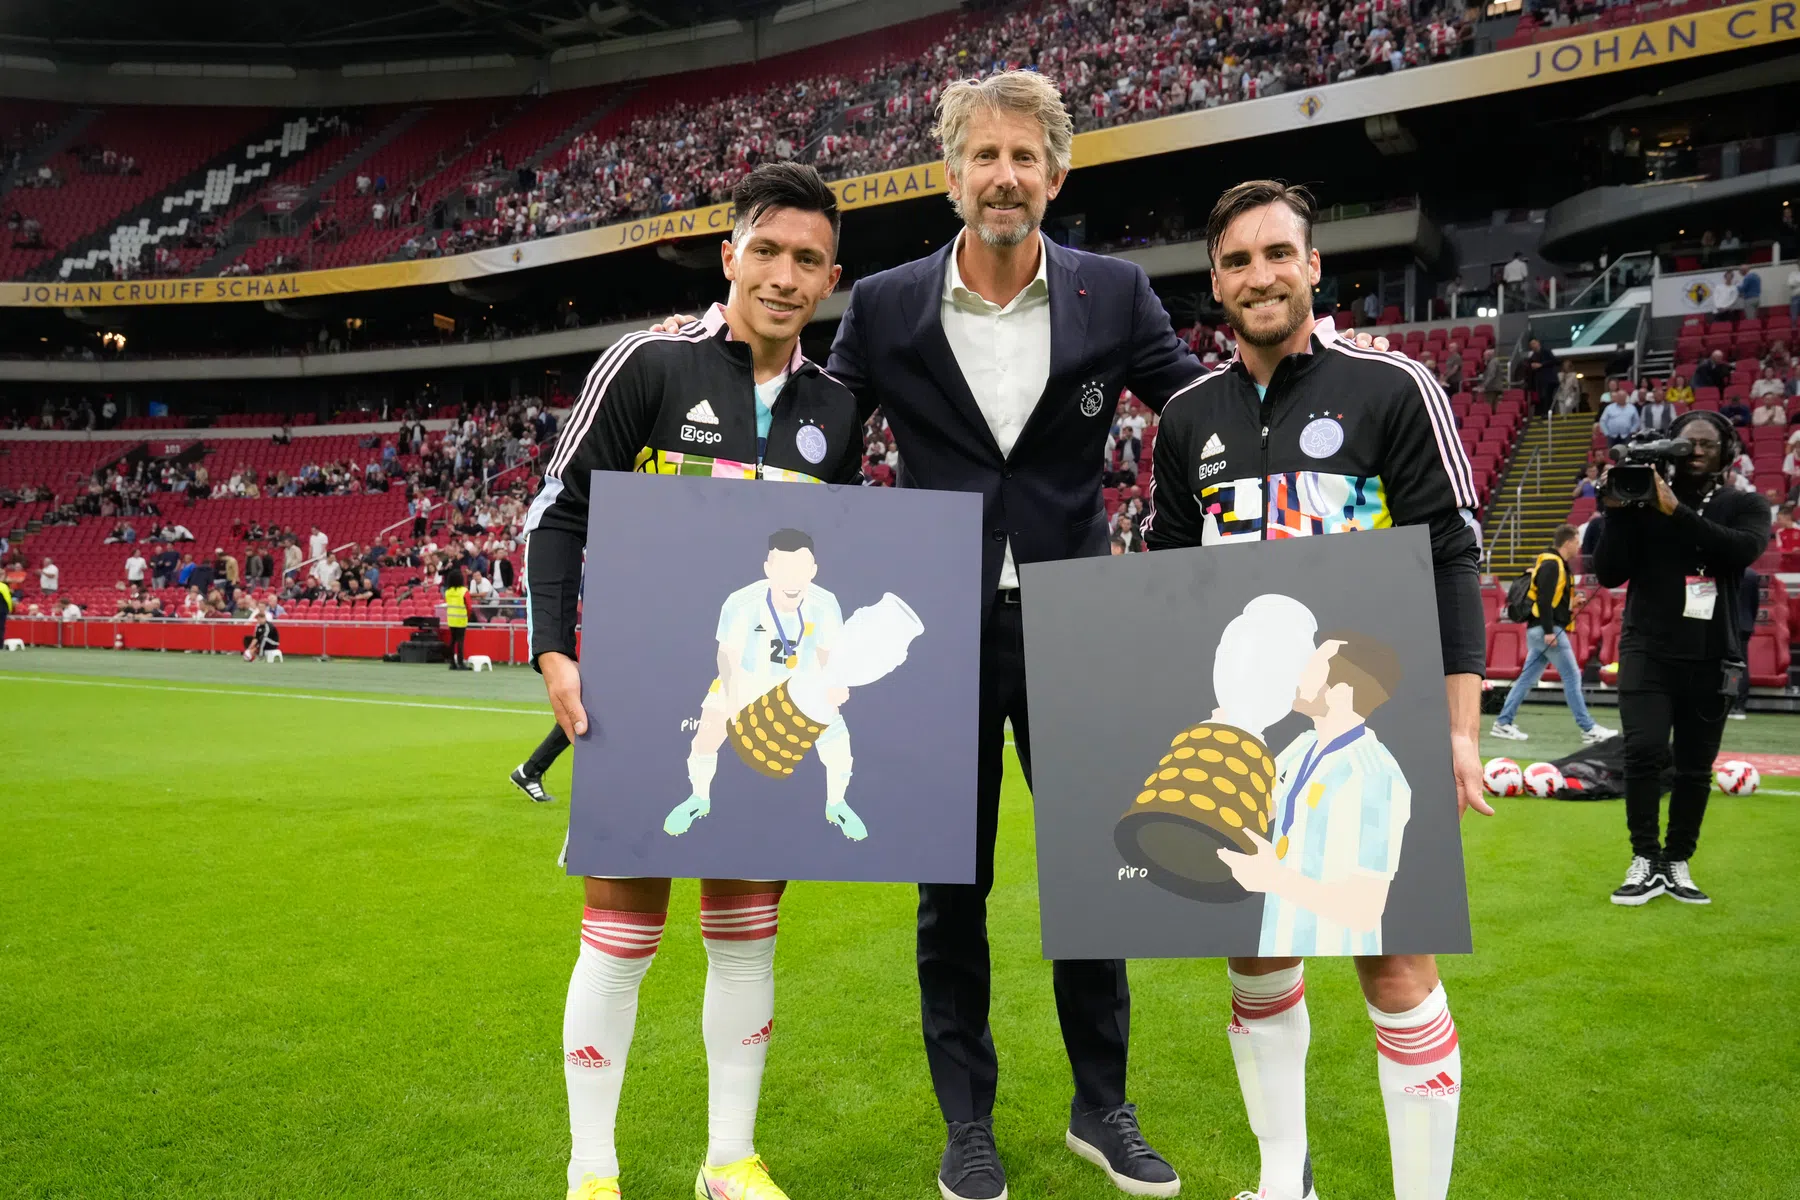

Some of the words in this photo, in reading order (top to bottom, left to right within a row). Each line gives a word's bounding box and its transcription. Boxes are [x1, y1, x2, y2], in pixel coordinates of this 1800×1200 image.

[1527, 20, 1697, 79] JOHAN
[619, 214, 695, 245] JOHAN
[831, 168, 936, 204] CHAAL
[21, 285, 102, 302] JOHAN
[112, 282, 205, 300] CRUIJFF
[216, 277, 300, 297] SCHAAL
[680, 425, 722, 444] Ziggo
[1198, 460, 1227, 480] Ziggo
[1117, 865, 1149, 881] piro
[565, 1053, 612, 1069] adidas
[1403, 1083, 1460, 1097] adidas
